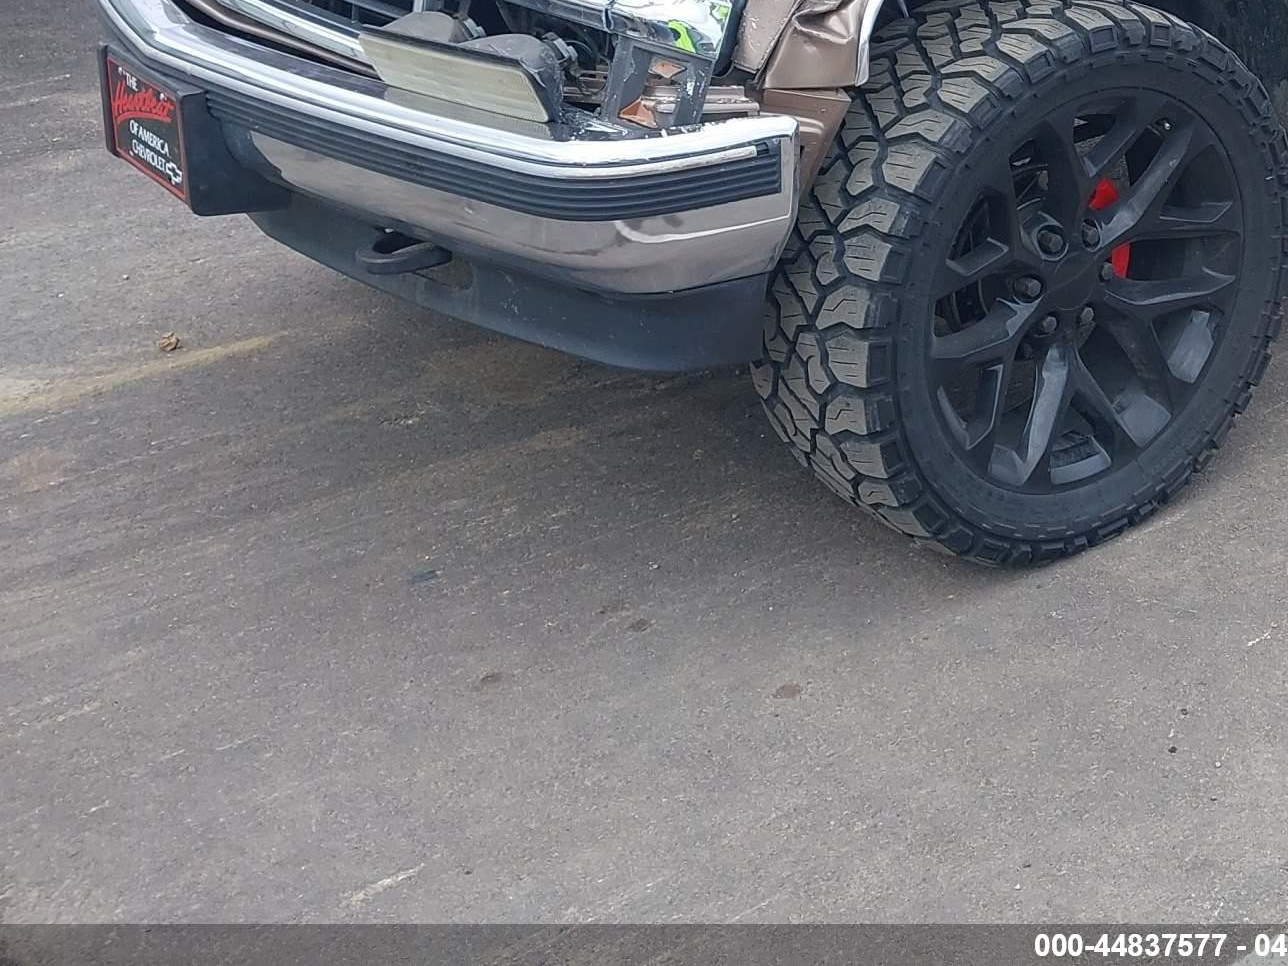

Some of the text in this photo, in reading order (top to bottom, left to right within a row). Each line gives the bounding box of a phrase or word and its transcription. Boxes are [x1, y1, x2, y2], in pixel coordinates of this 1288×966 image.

[125, 72, 138, 92] THE
[129, 120, 170, 157] OF AMERICA
[132, 139, 166, 173] CHEVROLET
